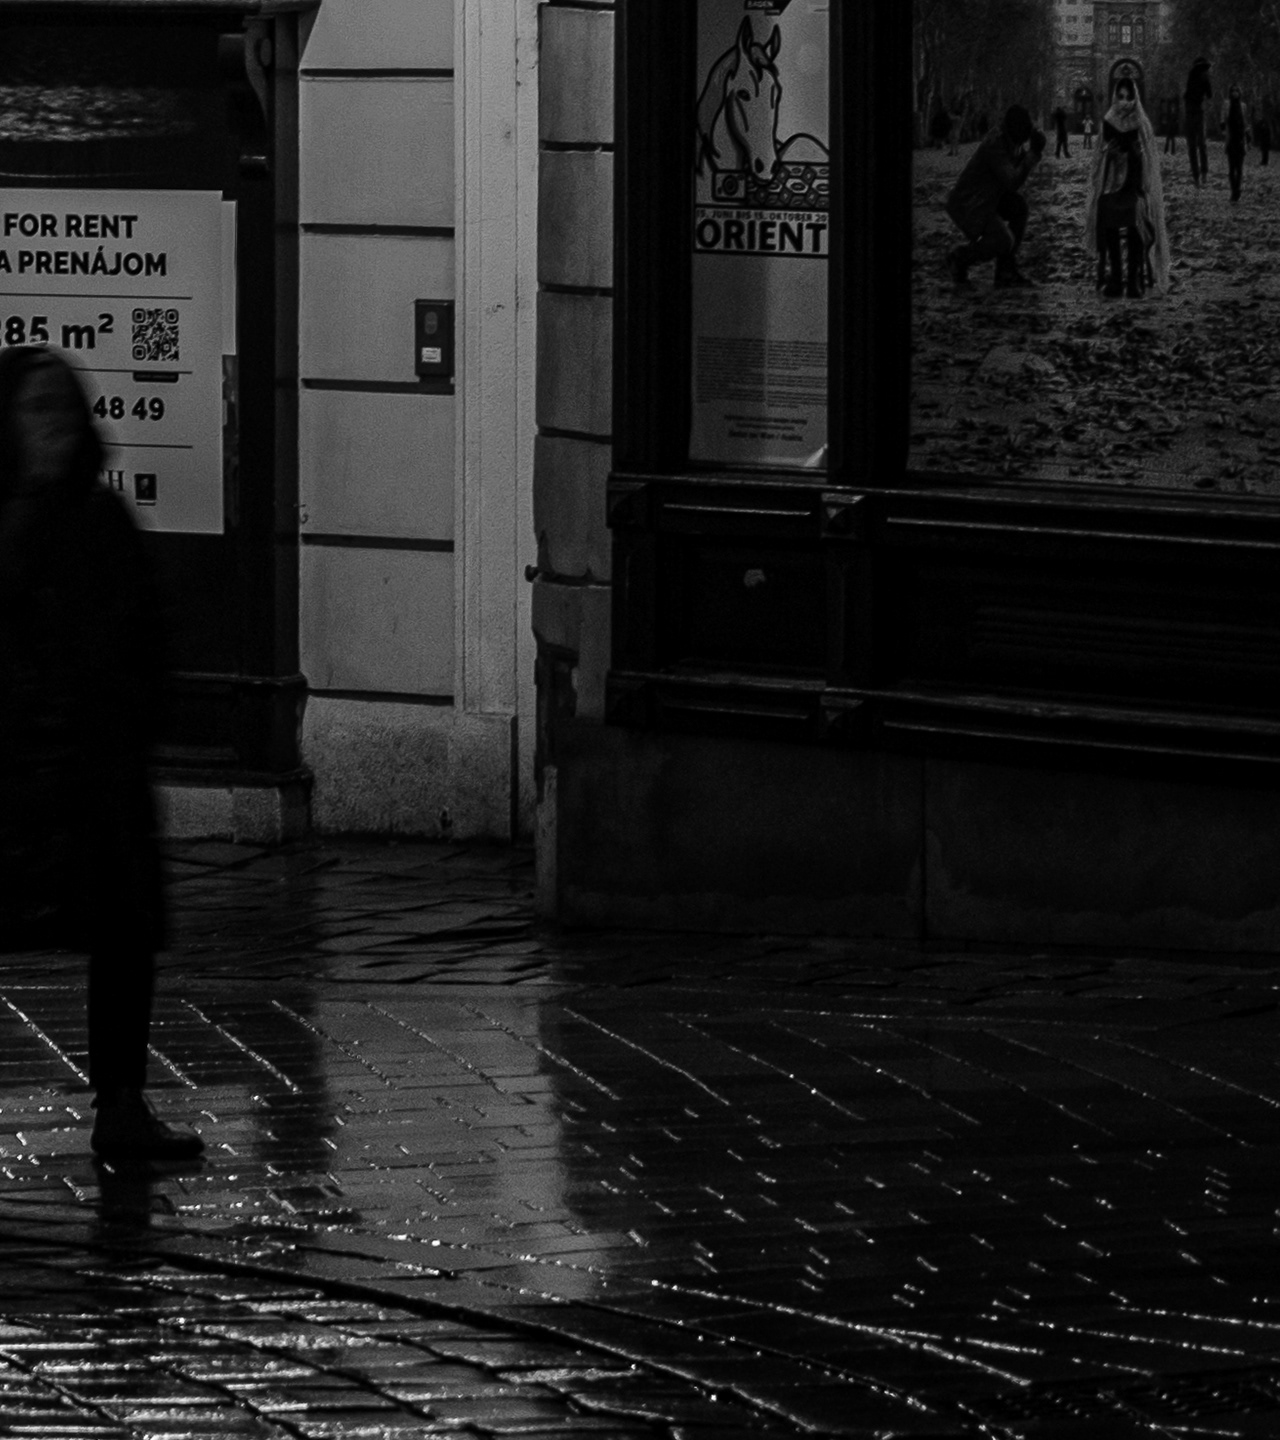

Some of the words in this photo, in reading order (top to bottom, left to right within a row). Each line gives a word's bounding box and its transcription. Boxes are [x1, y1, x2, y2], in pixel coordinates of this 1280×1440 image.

[3, 213, 58, 237] FOR
[65, 214, 138, 238] RENT
[696, 218, 827, 252] ORIENT
[18, 246, 167, 276] PRENÁJOM
[93, 395, 125, 420] 48
[131, 396, 165, 421] 49
